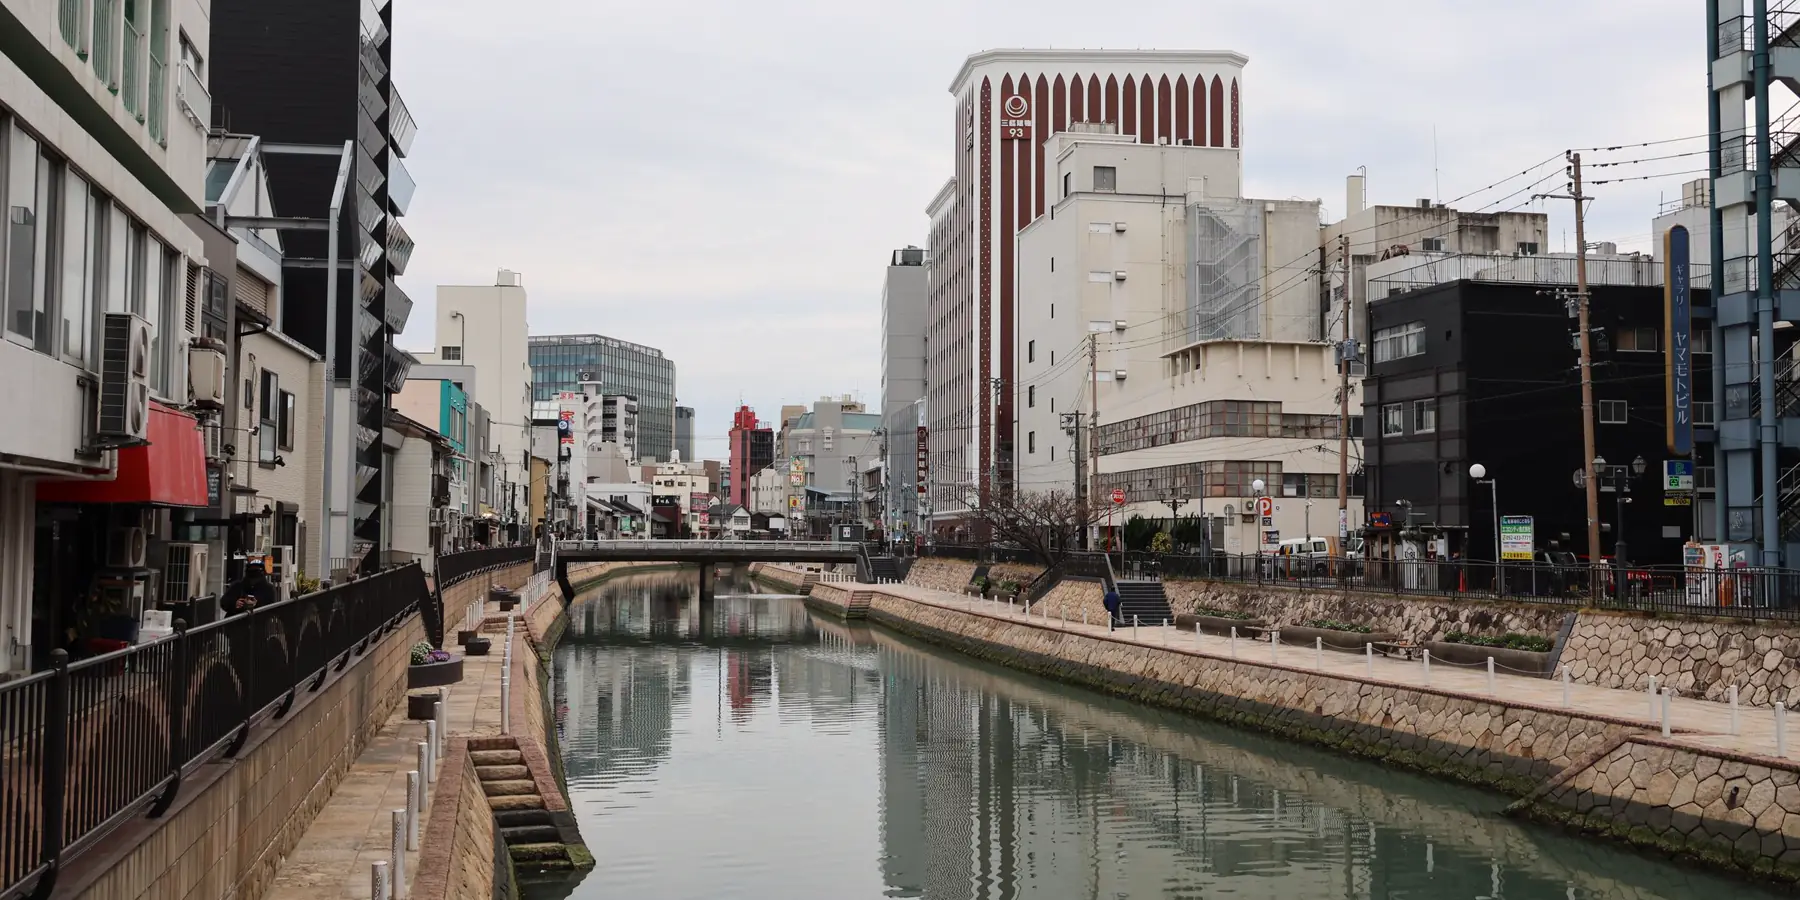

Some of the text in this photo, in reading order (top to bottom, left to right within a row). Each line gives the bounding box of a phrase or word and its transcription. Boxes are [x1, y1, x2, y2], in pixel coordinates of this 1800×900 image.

[1009, 128, 1023, 138] 93
[1674, 264, 1690, 425] ギャラリー ヤマモトビル
[1260, 499, 1271, 516] P
